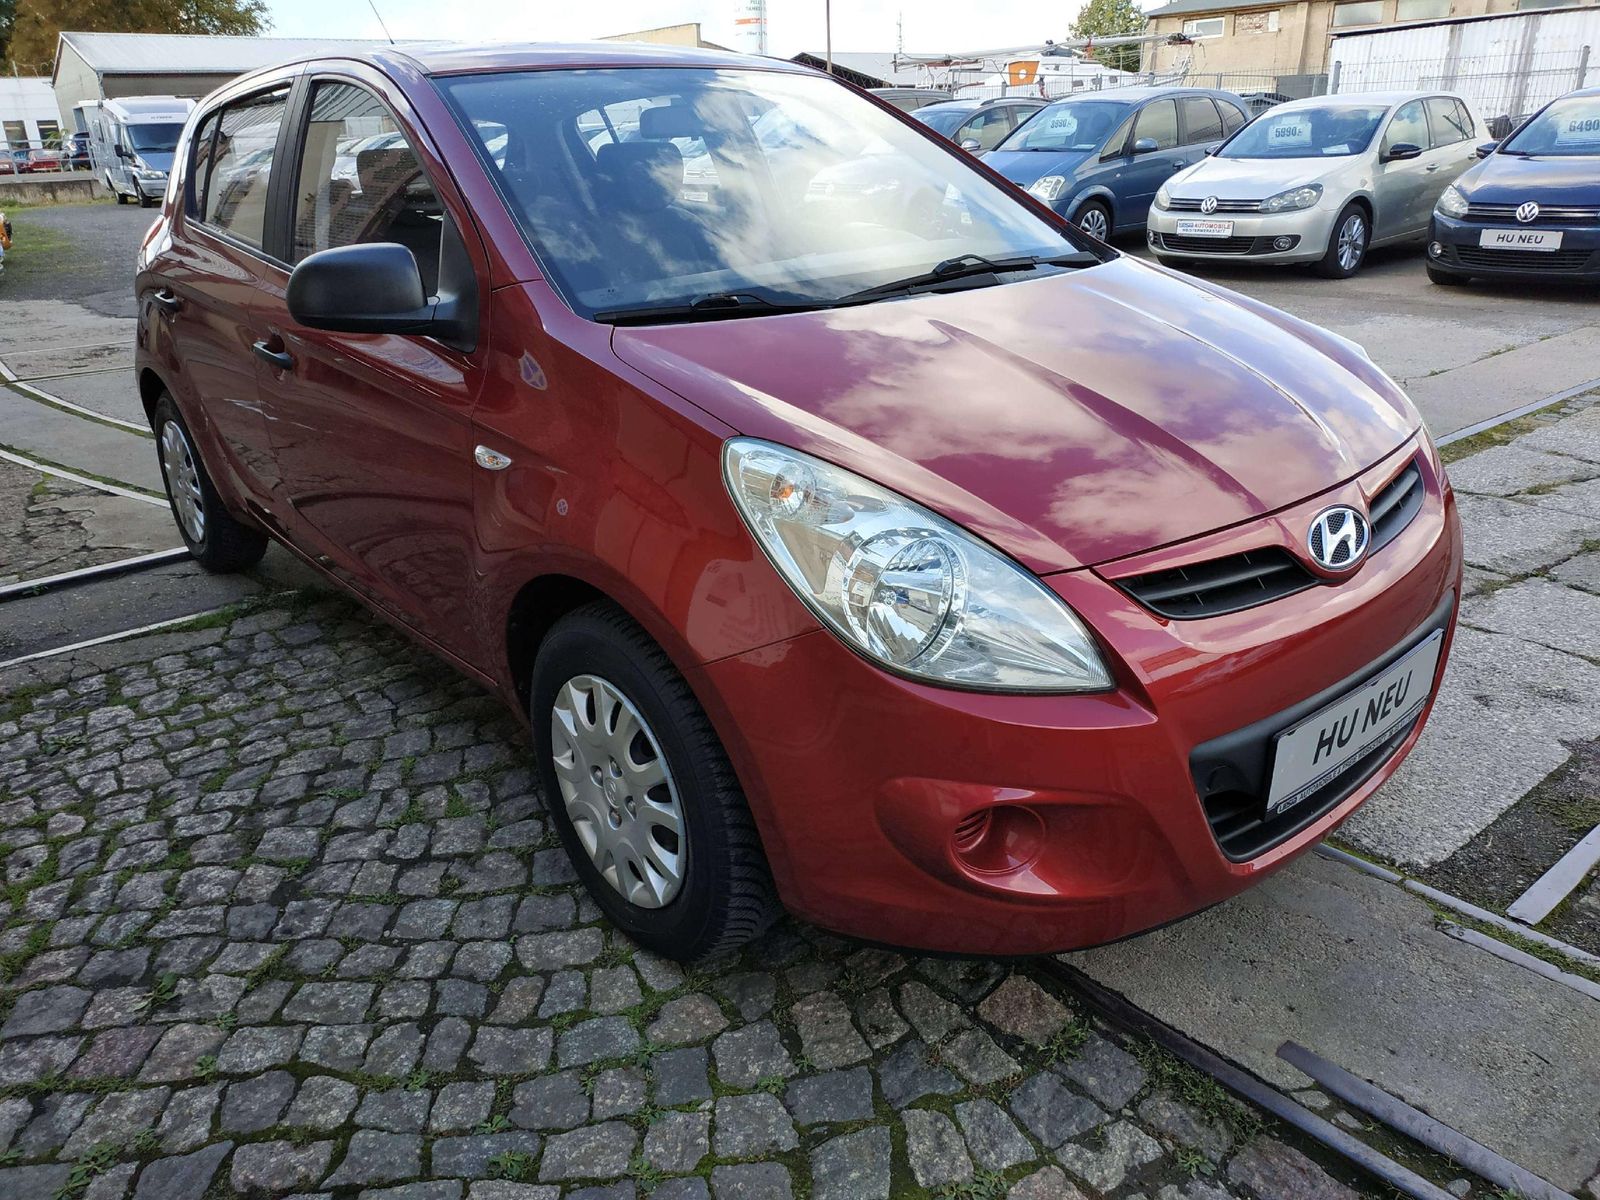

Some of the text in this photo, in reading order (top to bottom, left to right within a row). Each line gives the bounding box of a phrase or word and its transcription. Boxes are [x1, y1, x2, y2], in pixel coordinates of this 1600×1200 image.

[1496, 233, 1544, 245] HU NEU
[1312, 707, 1360, 766] HU
[1361, 669, 1413, 734] NEU
